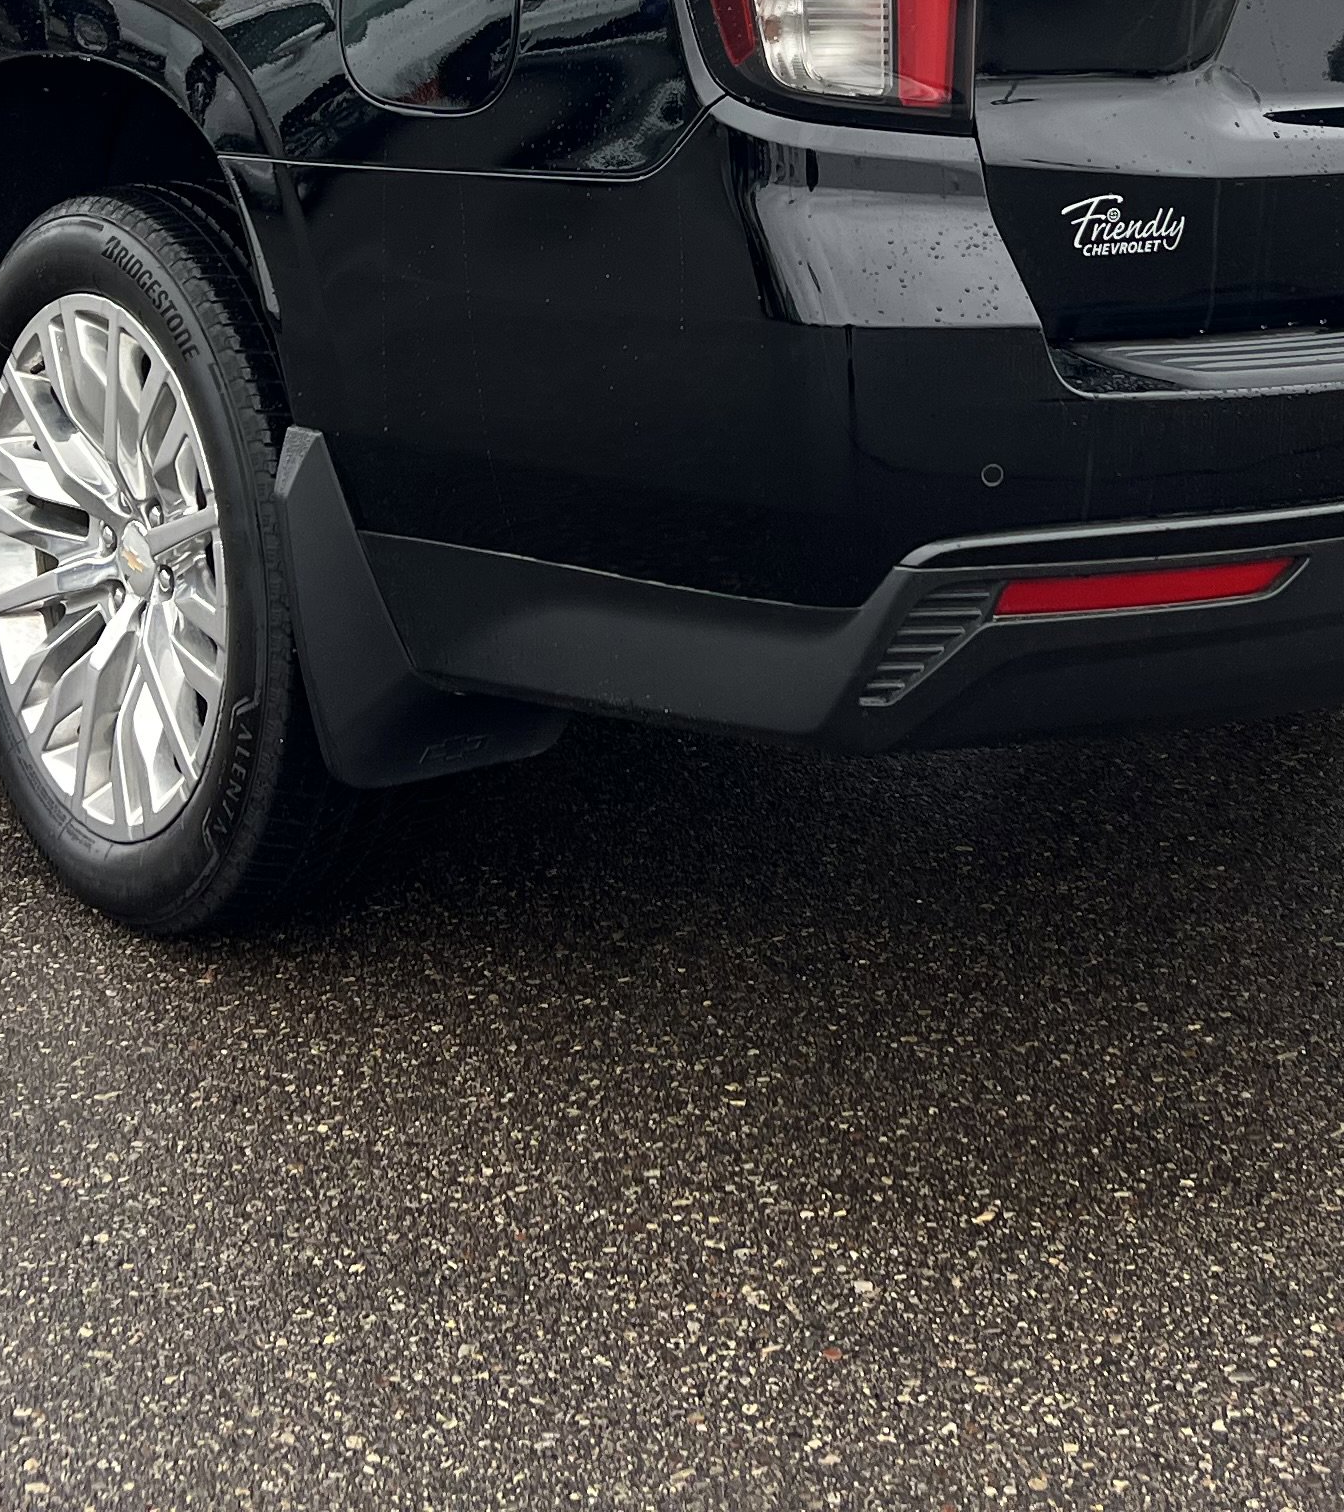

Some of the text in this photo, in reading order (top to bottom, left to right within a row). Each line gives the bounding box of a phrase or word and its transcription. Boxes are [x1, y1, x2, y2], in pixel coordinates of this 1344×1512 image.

[1060, 194, 1186, 251] Friendly
[1082, 239, 1162, 257] CHEVROLET
[101, 235, 200, 363] BRIDGESTONE
